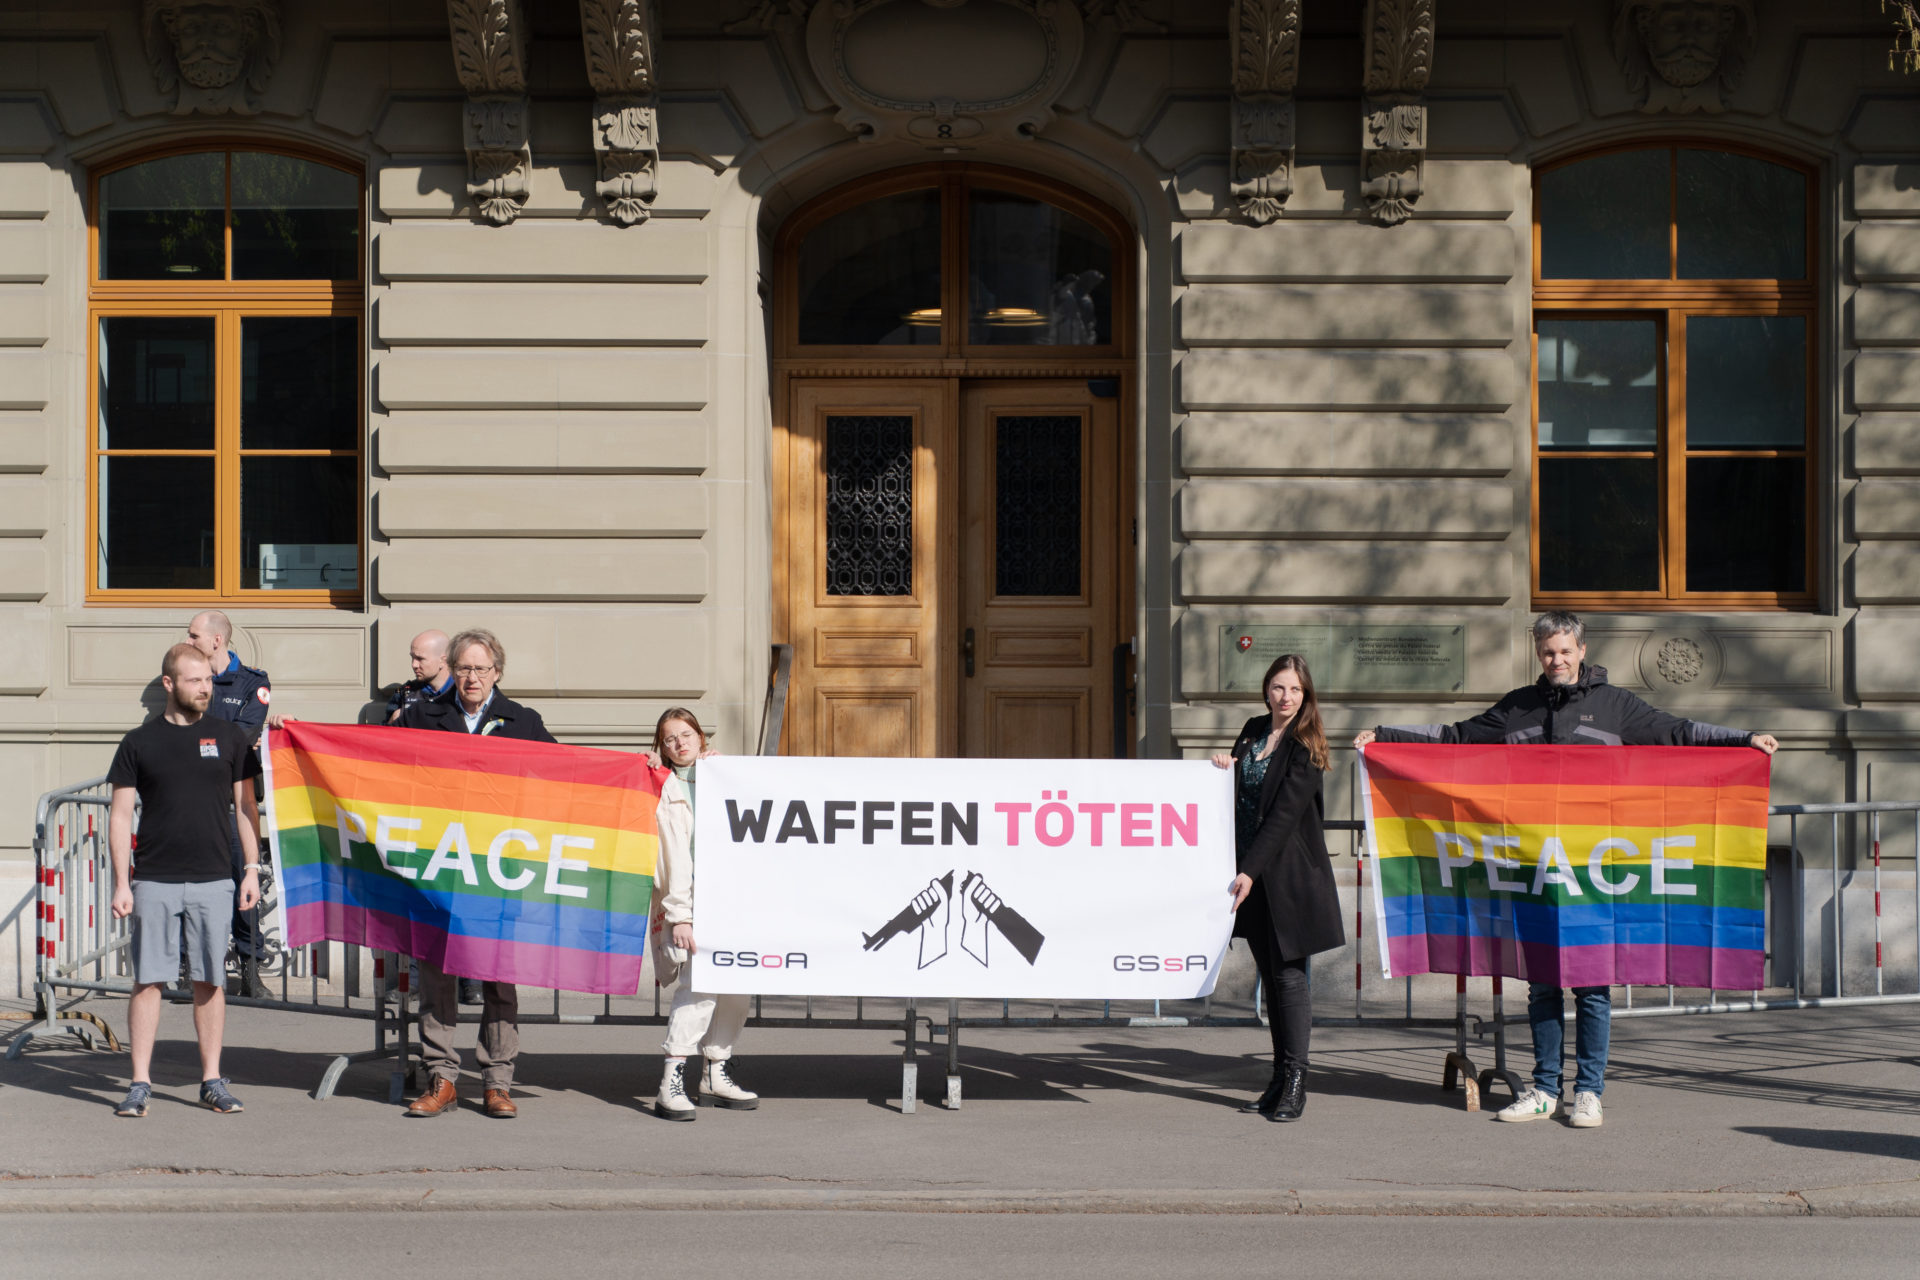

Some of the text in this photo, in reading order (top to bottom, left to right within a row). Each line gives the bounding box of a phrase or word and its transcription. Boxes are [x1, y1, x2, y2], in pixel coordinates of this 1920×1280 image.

[938, 124, 952, 138] 8
[725, 790, 1198, 847] WAFFEN TÖTEN
[335, 803, 595, 899] PEACE
[1434, 832, 1697, 896] PEACE
[712, 951, 808, 969] GSoA
[1113, 954, 1208, 972] GSsA
